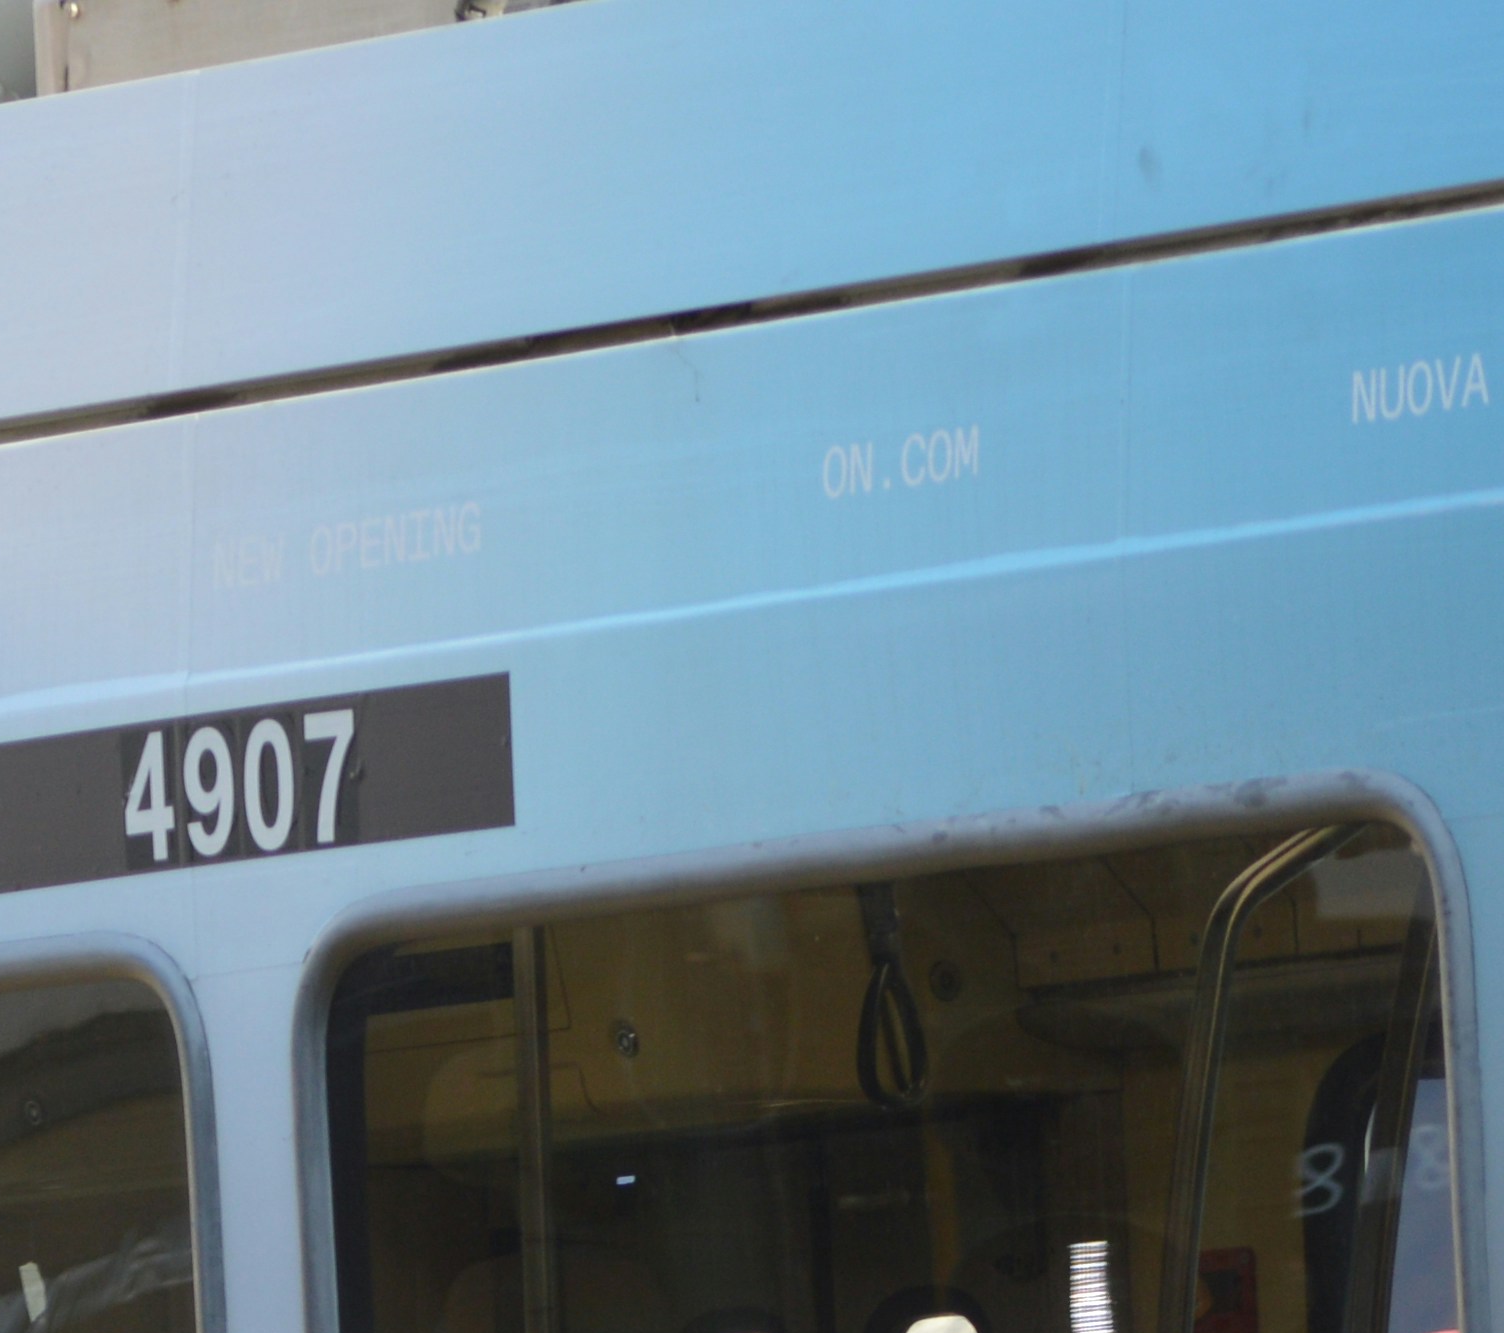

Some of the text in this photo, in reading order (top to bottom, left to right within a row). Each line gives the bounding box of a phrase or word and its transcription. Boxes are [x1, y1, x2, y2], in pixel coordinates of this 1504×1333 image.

[1353, 353, 1490, 424] NUOVA
[822, 425, 980, 499] ON.COM
[214, 500, 482, 595] NEW OPENING
[123, 708, 358, 862] 4907
